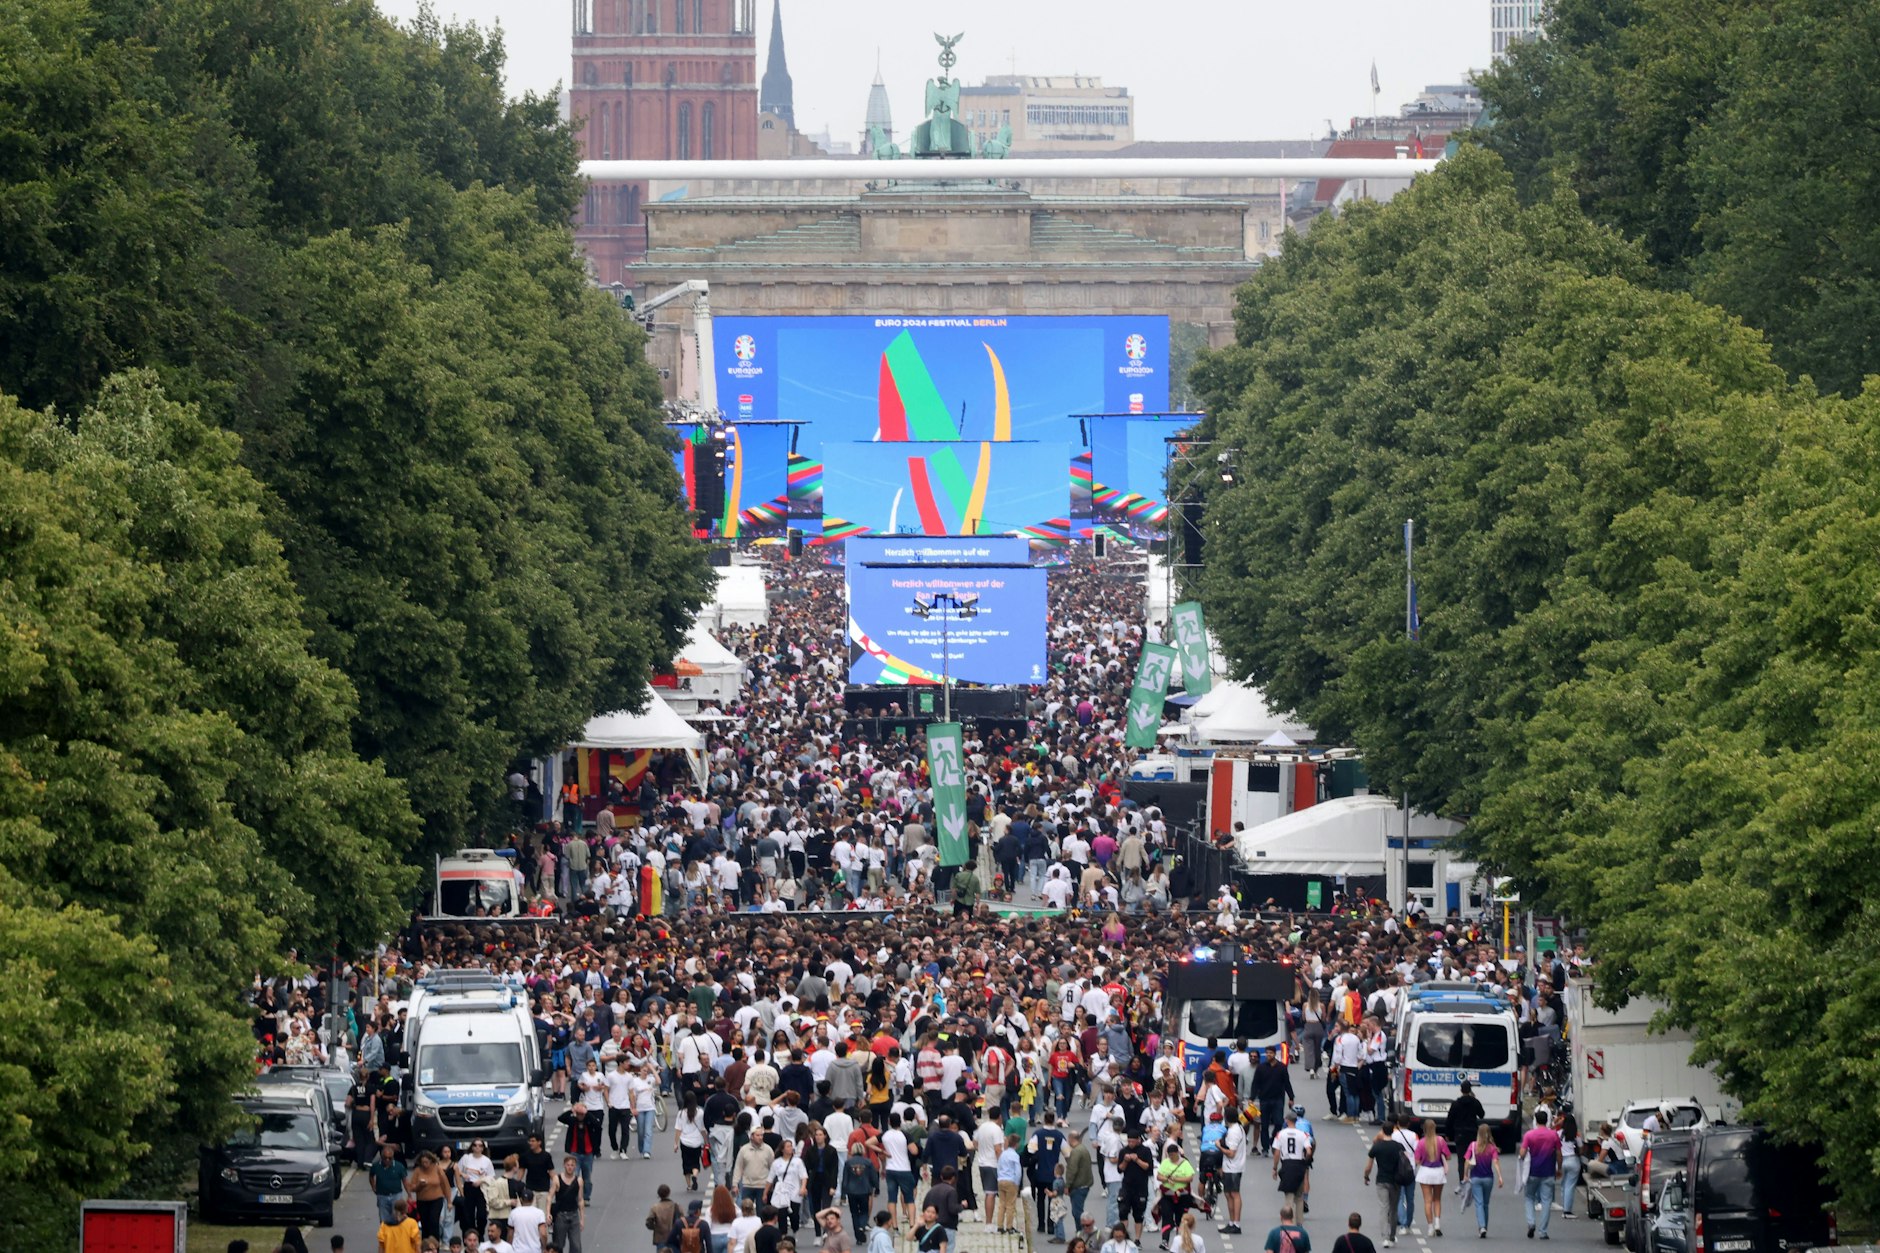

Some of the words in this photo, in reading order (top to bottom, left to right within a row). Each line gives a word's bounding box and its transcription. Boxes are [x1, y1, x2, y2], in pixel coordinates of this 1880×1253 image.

[875, 319, 901, 327] EURO
[903, 319, 926, 327] 2024
[928, 319, 971, 327] FESTIVAL
[973, 319, 1007, 327] BERLIN
[884, 548, 914, 556] Herzlich
[963, 548, 977, 556] auf
[977, 548, 990, 556] der
[892, 579, 924, 588] Herzlich
[925, 579, 974, 588] willkommen
[975, 579, 990, 588] auf
[990, 579, 1005, 588] der
[1415, 1073, 1455, 1082] POLIZEI
[447, 1091, 495, 1099] POLIZEI
[1287, 1137, 1296, 1154] 8
